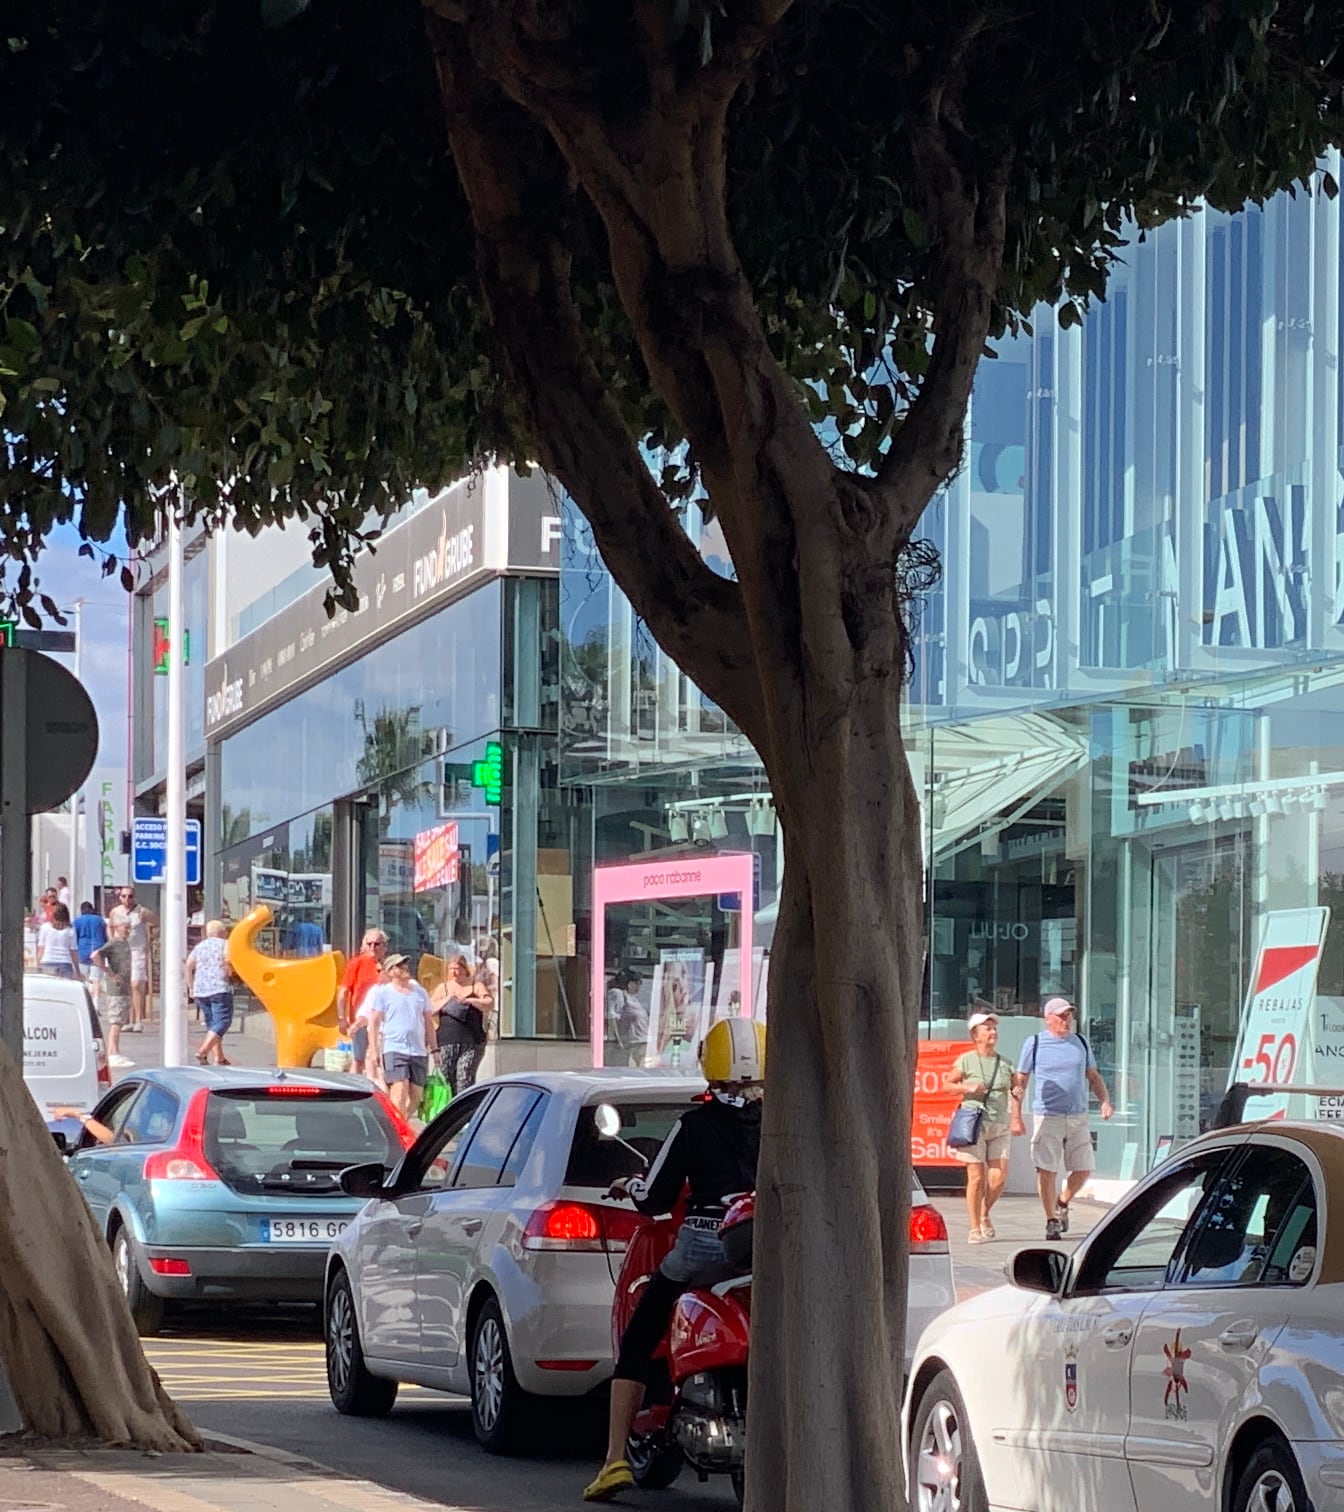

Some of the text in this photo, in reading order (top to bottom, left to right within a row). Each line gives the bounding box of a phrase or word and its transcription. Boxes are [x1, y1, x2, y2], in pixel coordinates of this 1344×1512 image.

[643, 873, 664, 888] paco
[1257, 998, 1303, 1011] REBAJAS
[273, 1222, 319, 1238] 5816
